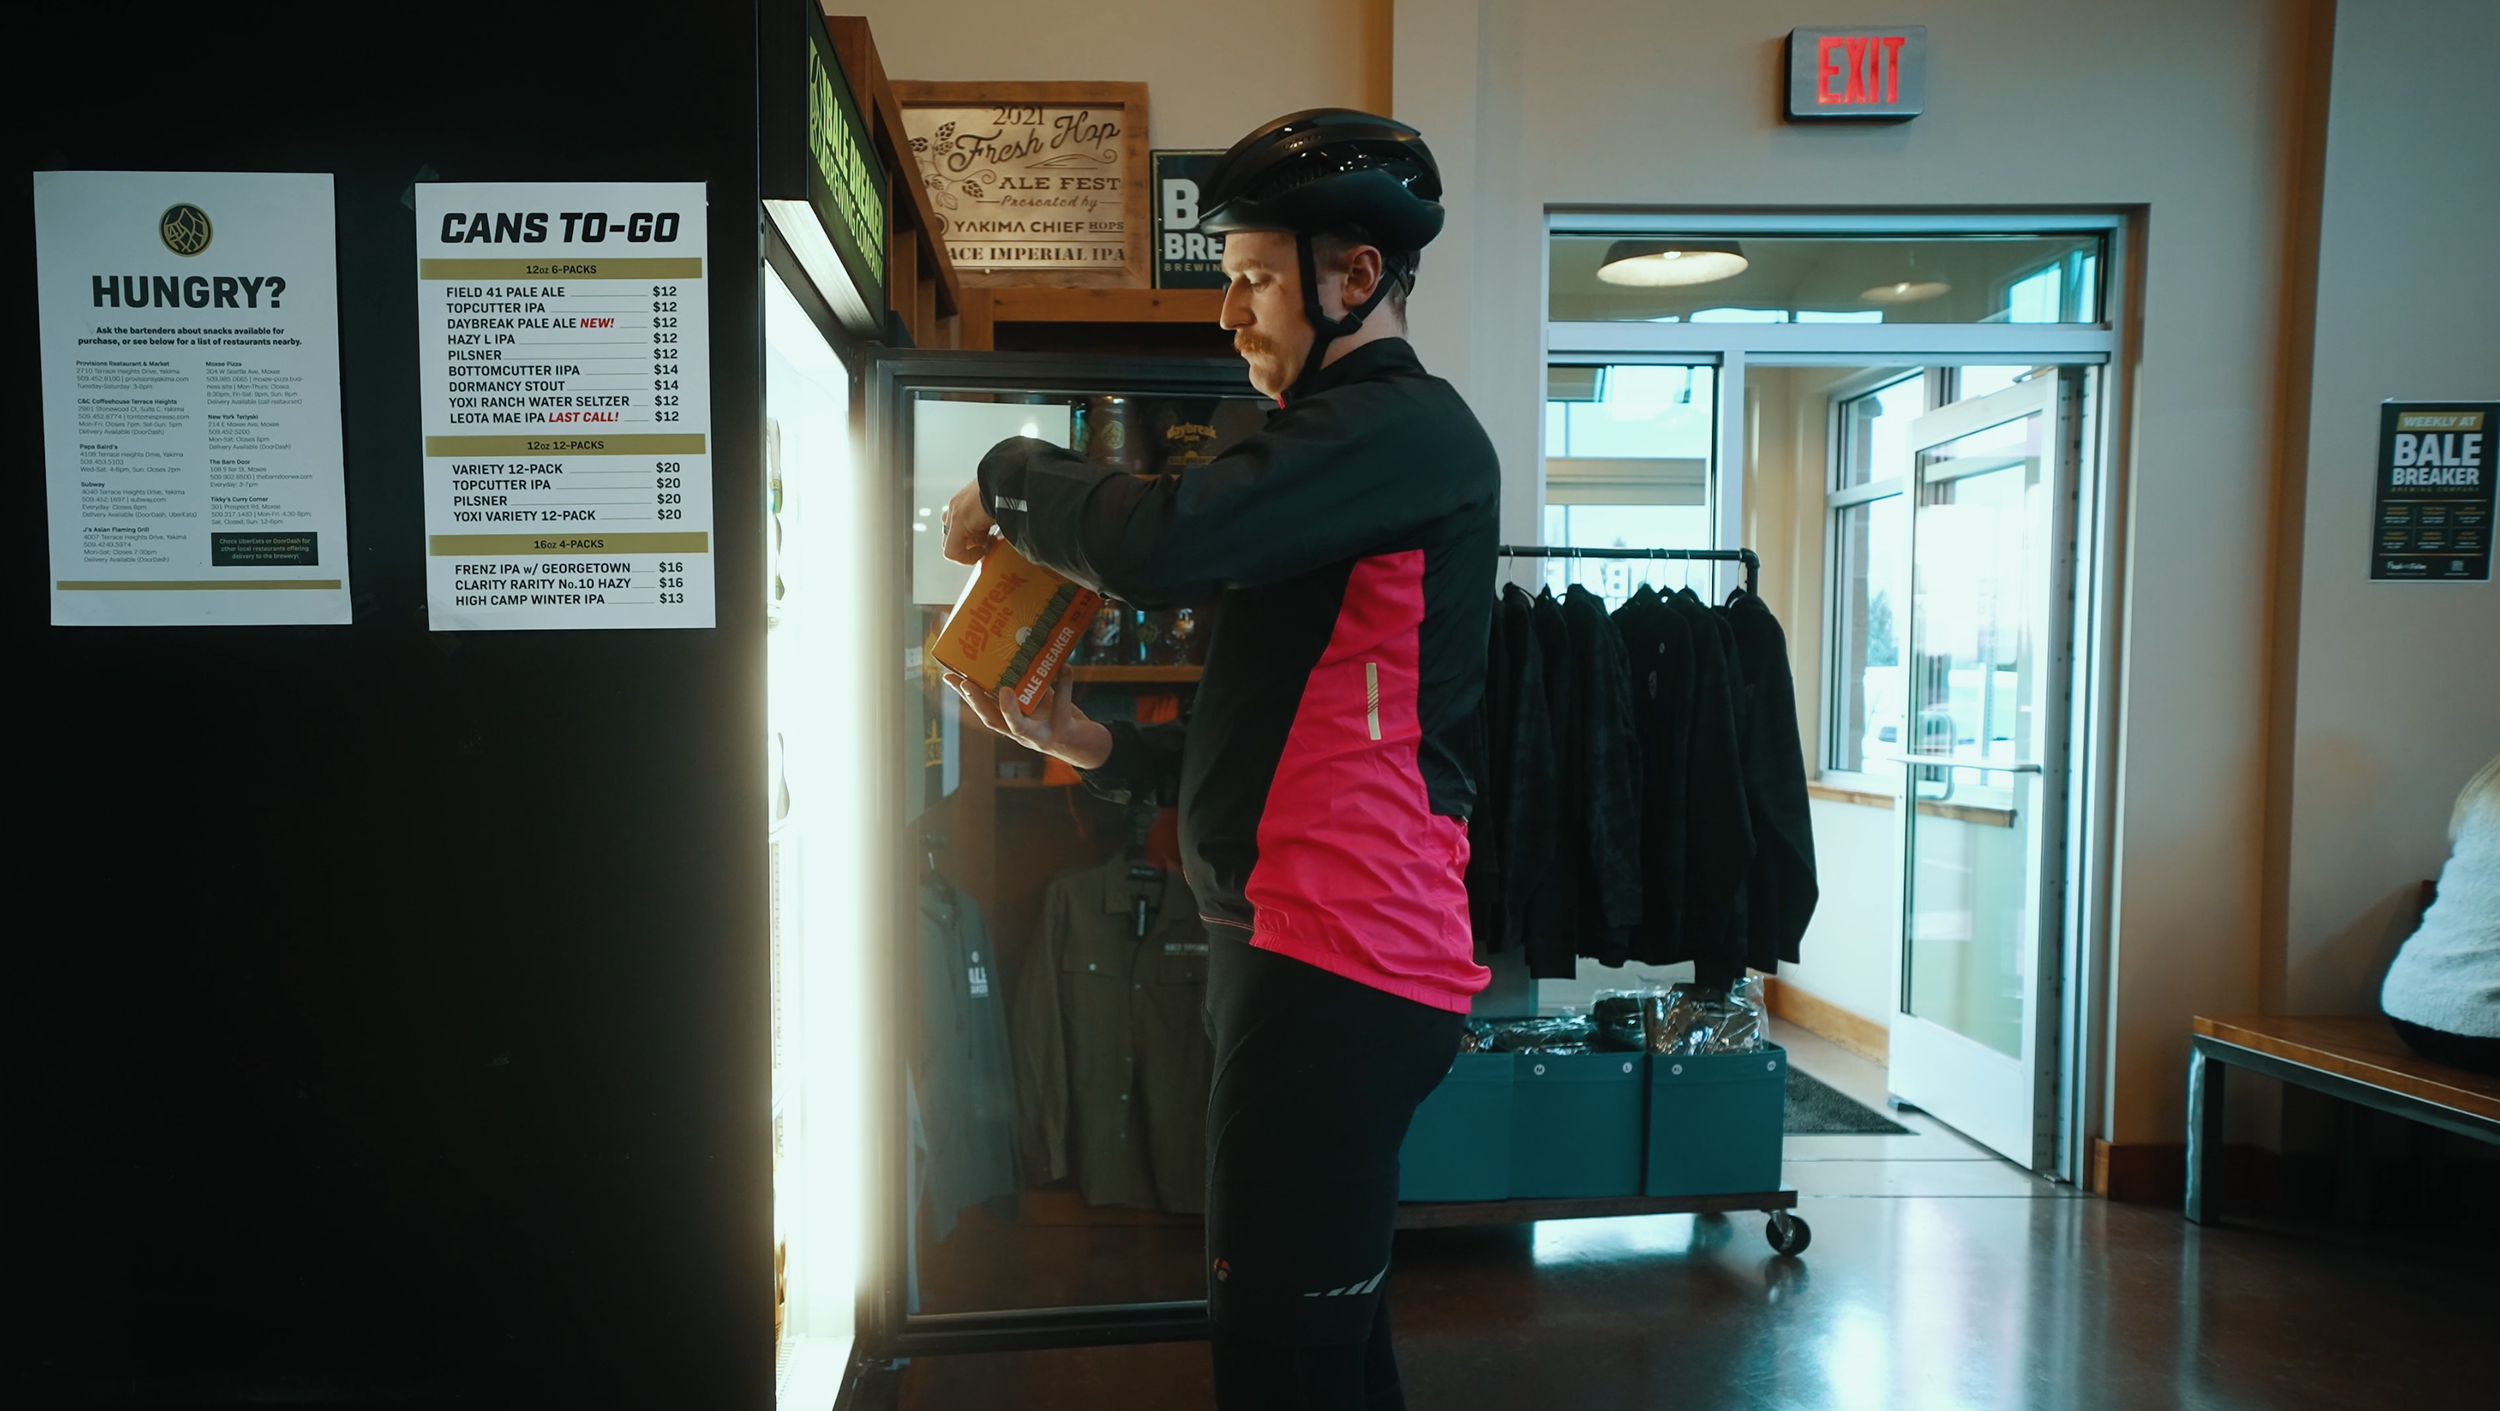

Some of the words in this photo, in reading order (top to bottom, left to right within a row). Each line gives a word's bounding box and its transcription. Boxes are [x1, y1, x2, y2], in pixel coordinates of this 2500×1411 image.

[1817, 36, 1906, 105] EXIT
[993, 106, 1045, 126] 2021
[947, 128, 1045, 173] Fresh
[1051, 110, 1120, 150] Hop
[826, 81, 849, 178] BALE
[850, 136, 883, 255] BREAKER
[999, 177, 1050, 190] ALE
[1060, 177, 1122, 190] FEST
[1001, 194, 1079, 208] Presented
[1080, 195, 1100, 212] by
[825, 146, 855, 238] BREWING
[856, 213, 883, 288] COMPANY
[441, 212, 548, 243] CANS
[560, 212, 680, 243] TO-GO
[954, 221, 1025, 232] YAKIMA
[1030, 221, 1085, 233] CHIEF
[1089, 222, 1124, 230] HOPS
[991, 248, 1087, 260] IMPERIAL
[1092, 248, 1124, 260] IPA
[526, 265, 549, 274] 12oz
[552, 265, 597, 274] 6-PACKS
[1164, 263, 1222, 272] BREWIN
[92, 275, 286, 308] HUNGRY?
[447, 287, 482, 298] FIELD
[486, 287, 502, 297] 41
[506, 287, 538, 297] PALE
[541, 287, 565, 297] ALE
[653, 286, 677, 297] $12
[446, 303, 521, 313] TOPCUTTER
[525, 303, 545, 313] IPA
[653, 301, 677, 313] $12
[448, 318, 514, 329] DAYBREAK
[518, 318, 549, 328] PALE
[553, 318, 576, 328] ALE
[580, 318, 614, 328] NEW!
[653, 317, 677, 328] $12
[96, 326, 113, 334] Ask
[177, 326, 202, 335] about
[203, 327, 233, 335] snacks
[234, 327, 271, 335] available
[272, 327, 285, 335] for
[78, 337, 120, 346] purchase,
[176, 337, 189, 346] for
[197, 337, 211, 346] list
[212, 337, 222, 346] of
[273, 338, 302, 346] nearby.
[448, 334, 481, 345] HAZY
[484, 334, 491, 344] L
[495, 334, 515, 344] IPA
[653, 333, 677, 344] $12
[448, 350, 501, 361] PILSNER
[654, 348, 678, 360] $12
[449, 365, 551, 376] BOTTOMCUTTER
[556, 365, 580, 375] IIPA
[654, 364, 678, 375] $14
[449, 381, 521, 392] DORMANCY
[525, 381, 565, 391] STOUT
[654, 379, 678, 391] $14
[449, 397, 477, 408] YOXI
[481, 397, 525, 407] RANCH
[528, 396, 572, 407] WATER
[576, 396, 629, 407] SELTZER
[655, 395, 679, 407] $12
[450, 413, 489, 423] LEOTA
[493, 413, 521, 423] MAE
[525, 412, 545, 423] IPA
[549, 412, 580, 422] LAST
[583, 412, 619, 422] CALL!
[655, 411, 679, 422] $12
[2403, 416, 2457, 428] WEEKLY
[2458, 416, 2477, 427] AT
[527, 441, 550, 450] 12oz
[553, 441, 604, 450] 12-PACKS
[2393, 433, 2483, 467] BALE
[452, 464, 504, 475] VARIETY
[508, 464, 563, 474] 12-PACK
[656, 462, 680, 473] $20
[2392, 467, 2480, 485] BREAKER
[453, 480, 527, 491] TOPCUTTER
[531, 479, 551, 490] IPA
[657, 477, 680, 489] $20
[454, 496, 507, 506] PILSNER
[657, 493, 681, 505] $20
[453, 511, 482, 522] YOXI
[485, 511, 537, 521] VARIETY
[541, 510, 596, 521] 12-PACK
[658, 509, 681, 520] $20
[534, 540, 556, 549] 16oz
[559, 539, 604, 548] 4-PACKS
[455, 564, 496, 575] FRENZ
[500, 564, 520, 574] IPA
[523, 563, 538, 575] w/
[542, 563, 630, 574] GEORGETOWN
[659, 561, 683, 573] $16
[455, 580, 507, 590] CLARITY
[510, 579, 555, 589] RARITY
[559, 578, 594, 589] No.10
[598, 578, 631, 588] HAZY
[659, 577, 683, 589] $16
[456, 595, 487, 606] HIGH
[491, 595, 528, 605] CAMP
[531, 594, 580, 605] WINTER
[585, 594, 605, 604] IPA
[660, 592, 684, 604] $13
[958, 571, 1029, 662] daybreak
[989, 606, 1014, 638] pale
[1018, 675, 1043, 706] BALE
[1038, 626, 1075, 676] BREAKER
